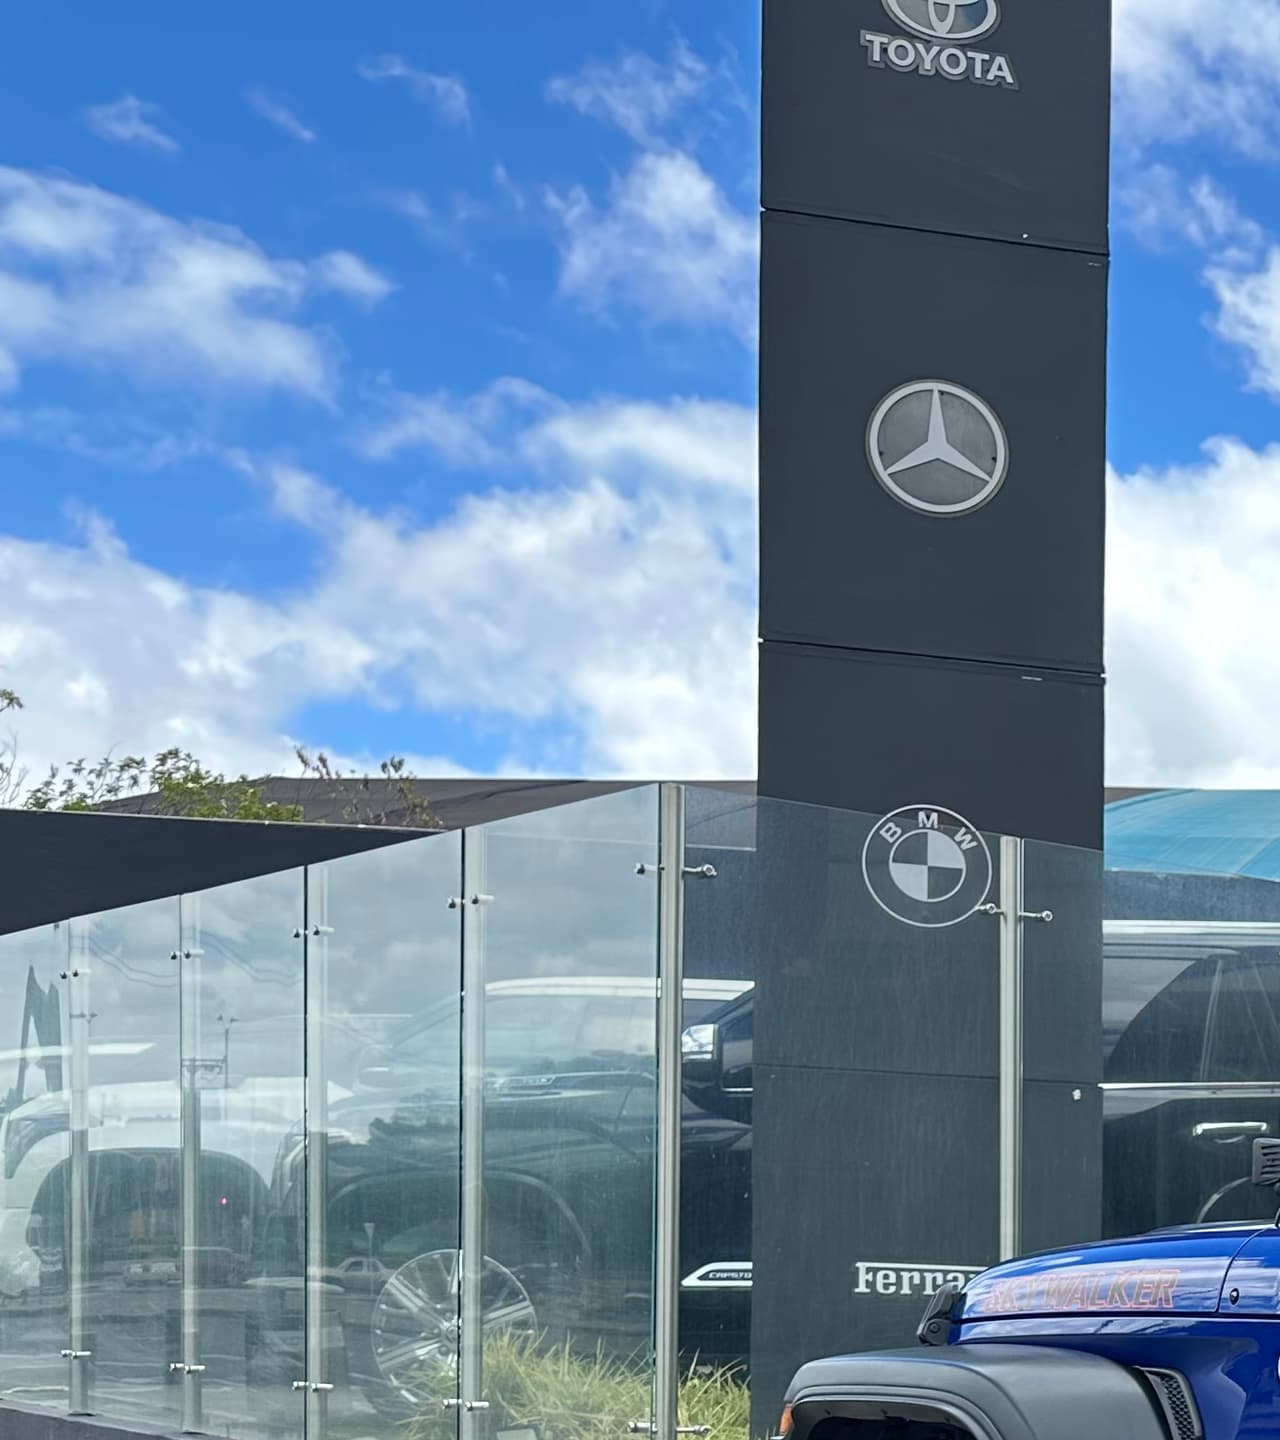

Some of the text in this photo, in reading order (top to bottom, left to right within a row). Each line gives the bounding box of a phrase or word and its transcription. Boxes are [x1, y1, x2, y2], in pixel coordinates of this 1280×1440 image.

[863, 32, 1016, 85] TOYOTA
[879, 810, 979, 852] BMW
[854, 1261, 987, 1296] Ferra
[983, 1268, 1181, 1313] SKYWALKER
